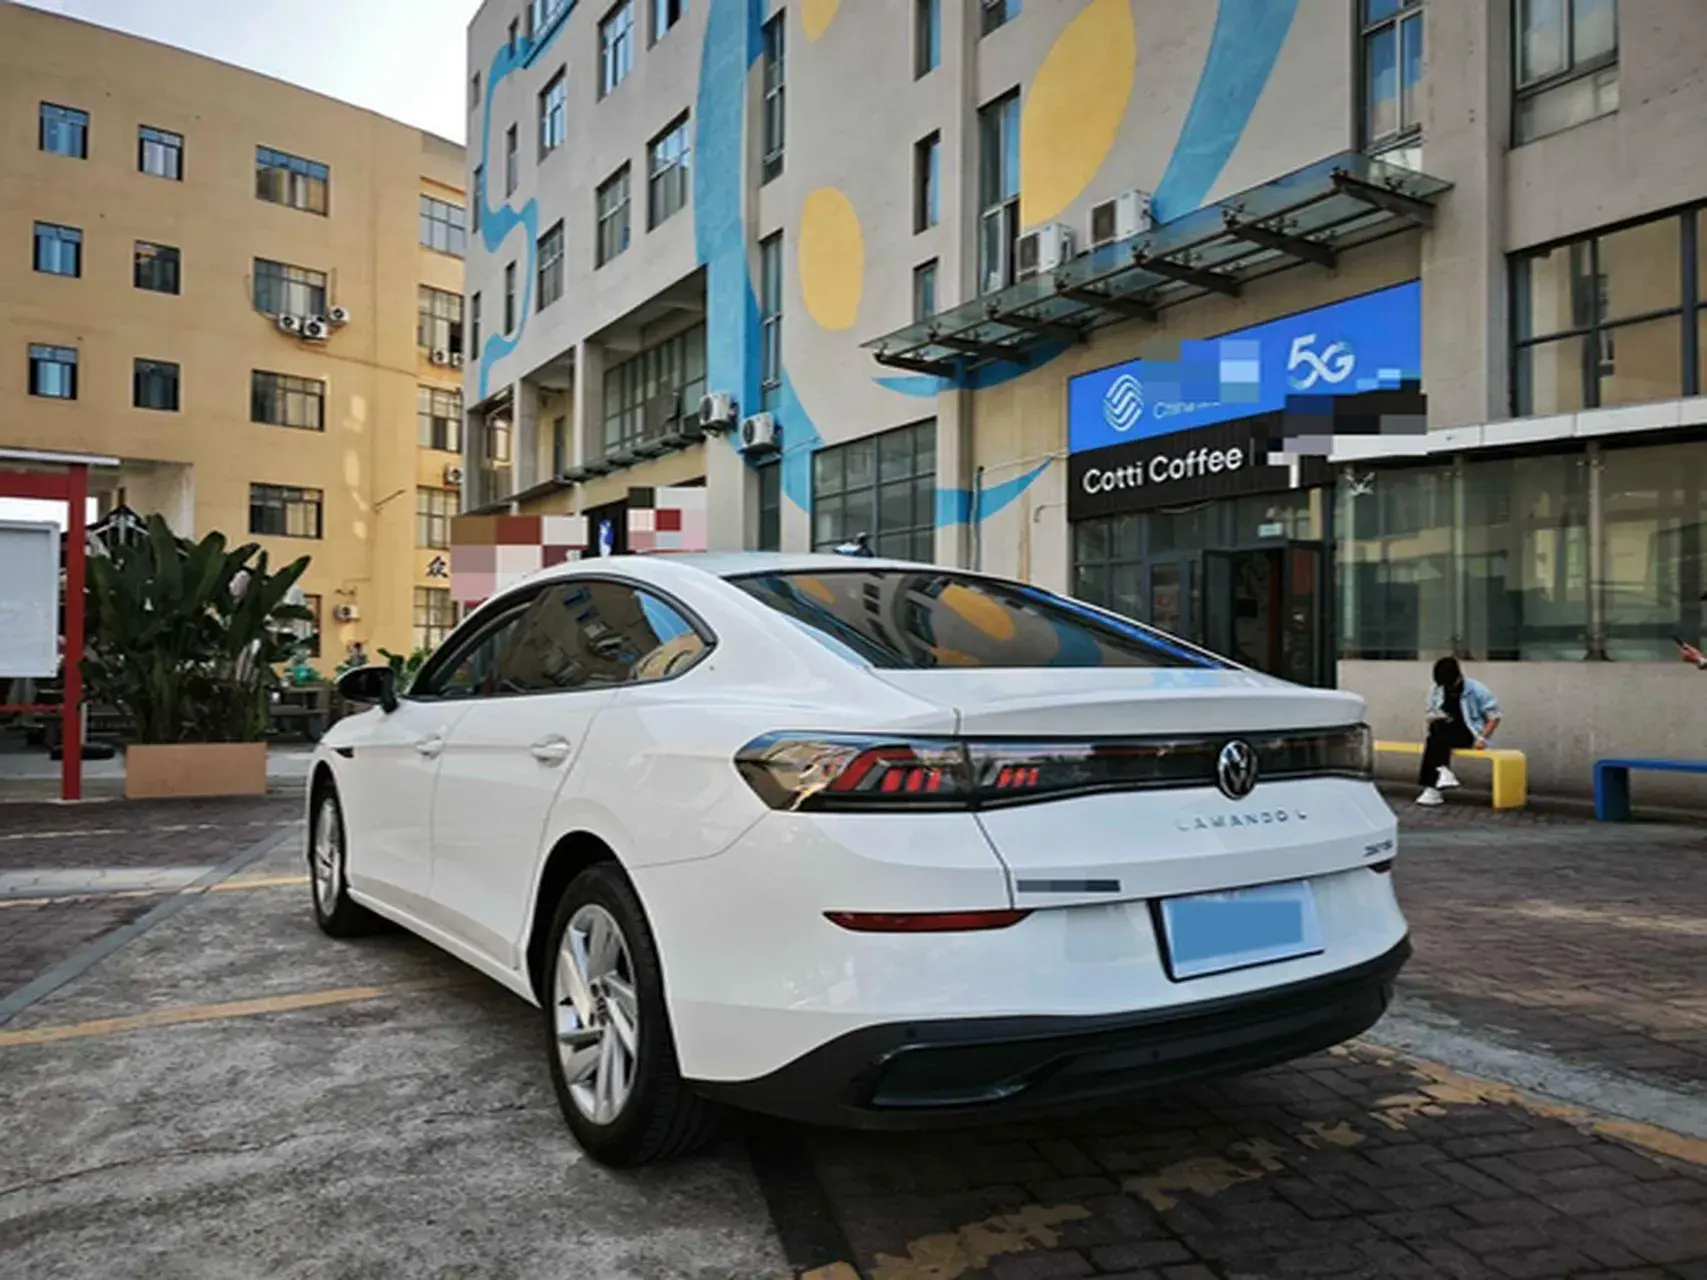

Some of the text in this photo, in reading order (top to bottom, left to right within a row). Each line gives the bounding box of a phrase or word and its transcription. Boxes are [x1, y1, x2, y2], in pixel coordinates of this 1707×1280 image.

[1287, 333, 1355, 390] 5G
[1083, 447, 1244, 494] Cotti Coffee
[1175, 808, 1289, 831] LAMANDO
